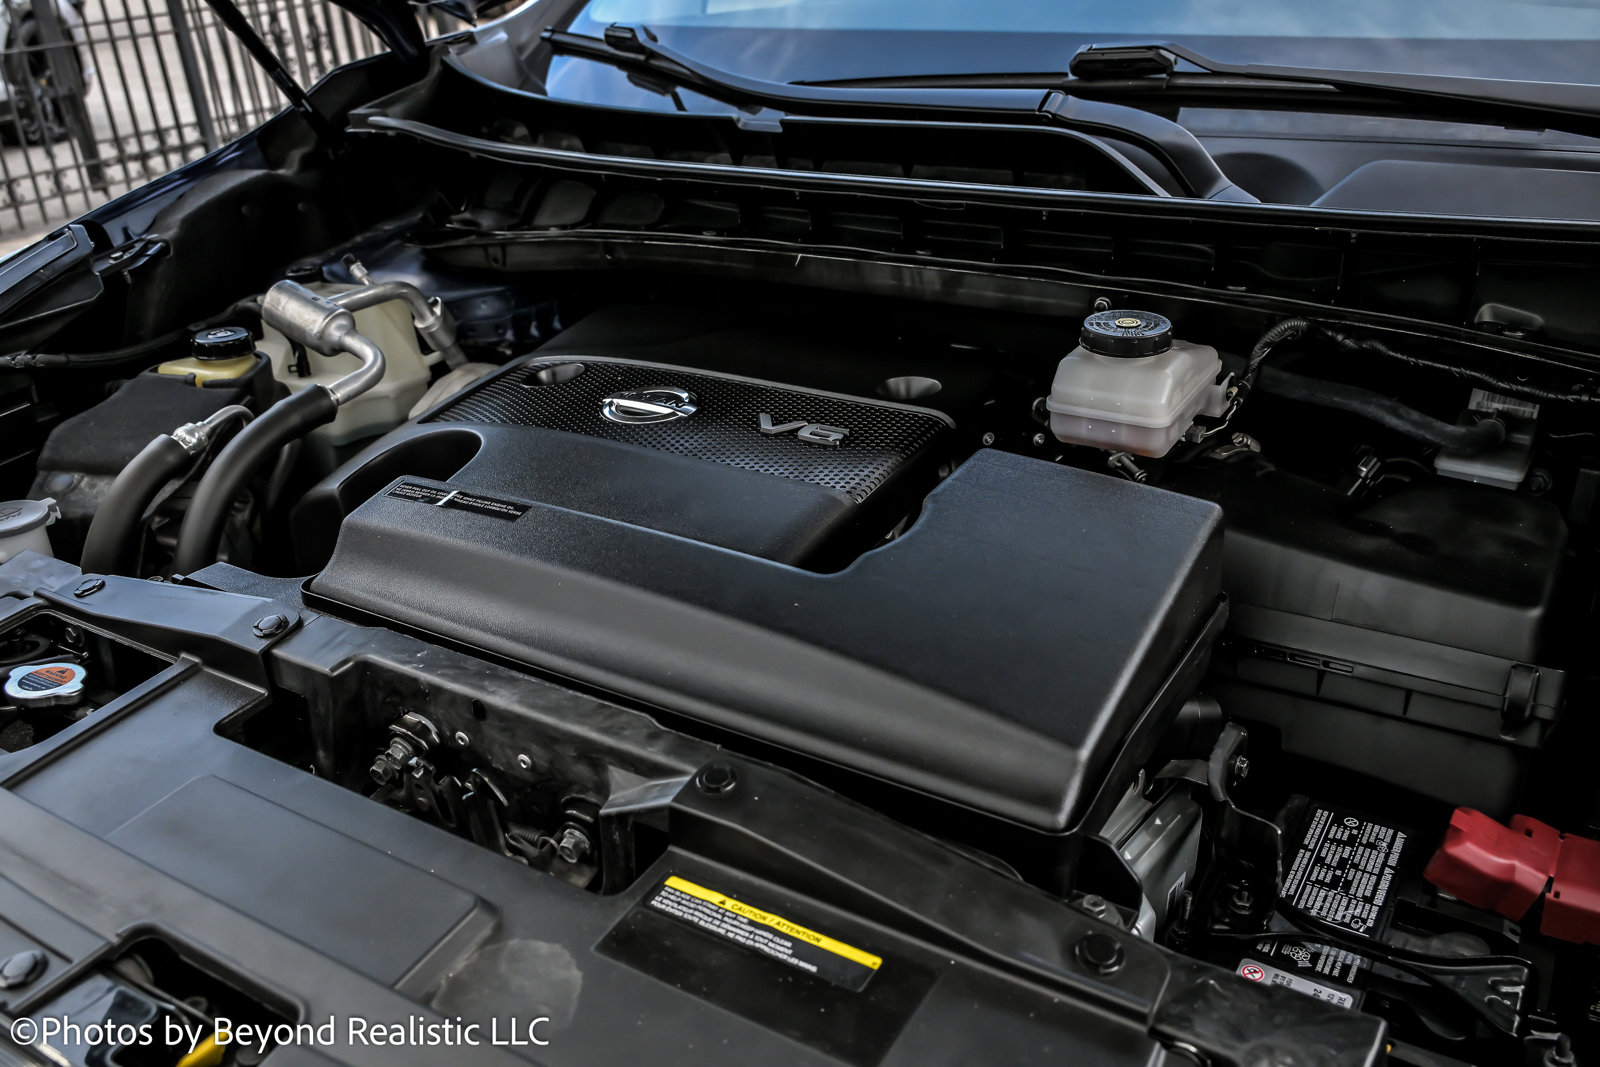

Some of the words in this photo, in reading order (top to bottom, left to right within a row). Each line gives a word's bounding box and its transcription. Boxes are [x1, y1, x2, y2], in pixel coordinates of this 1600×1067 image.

[760, 413, 849, 446] V6
[731, 903, 768, 921] CAUTION
[775, 920, 822, 943] ATTENTION
